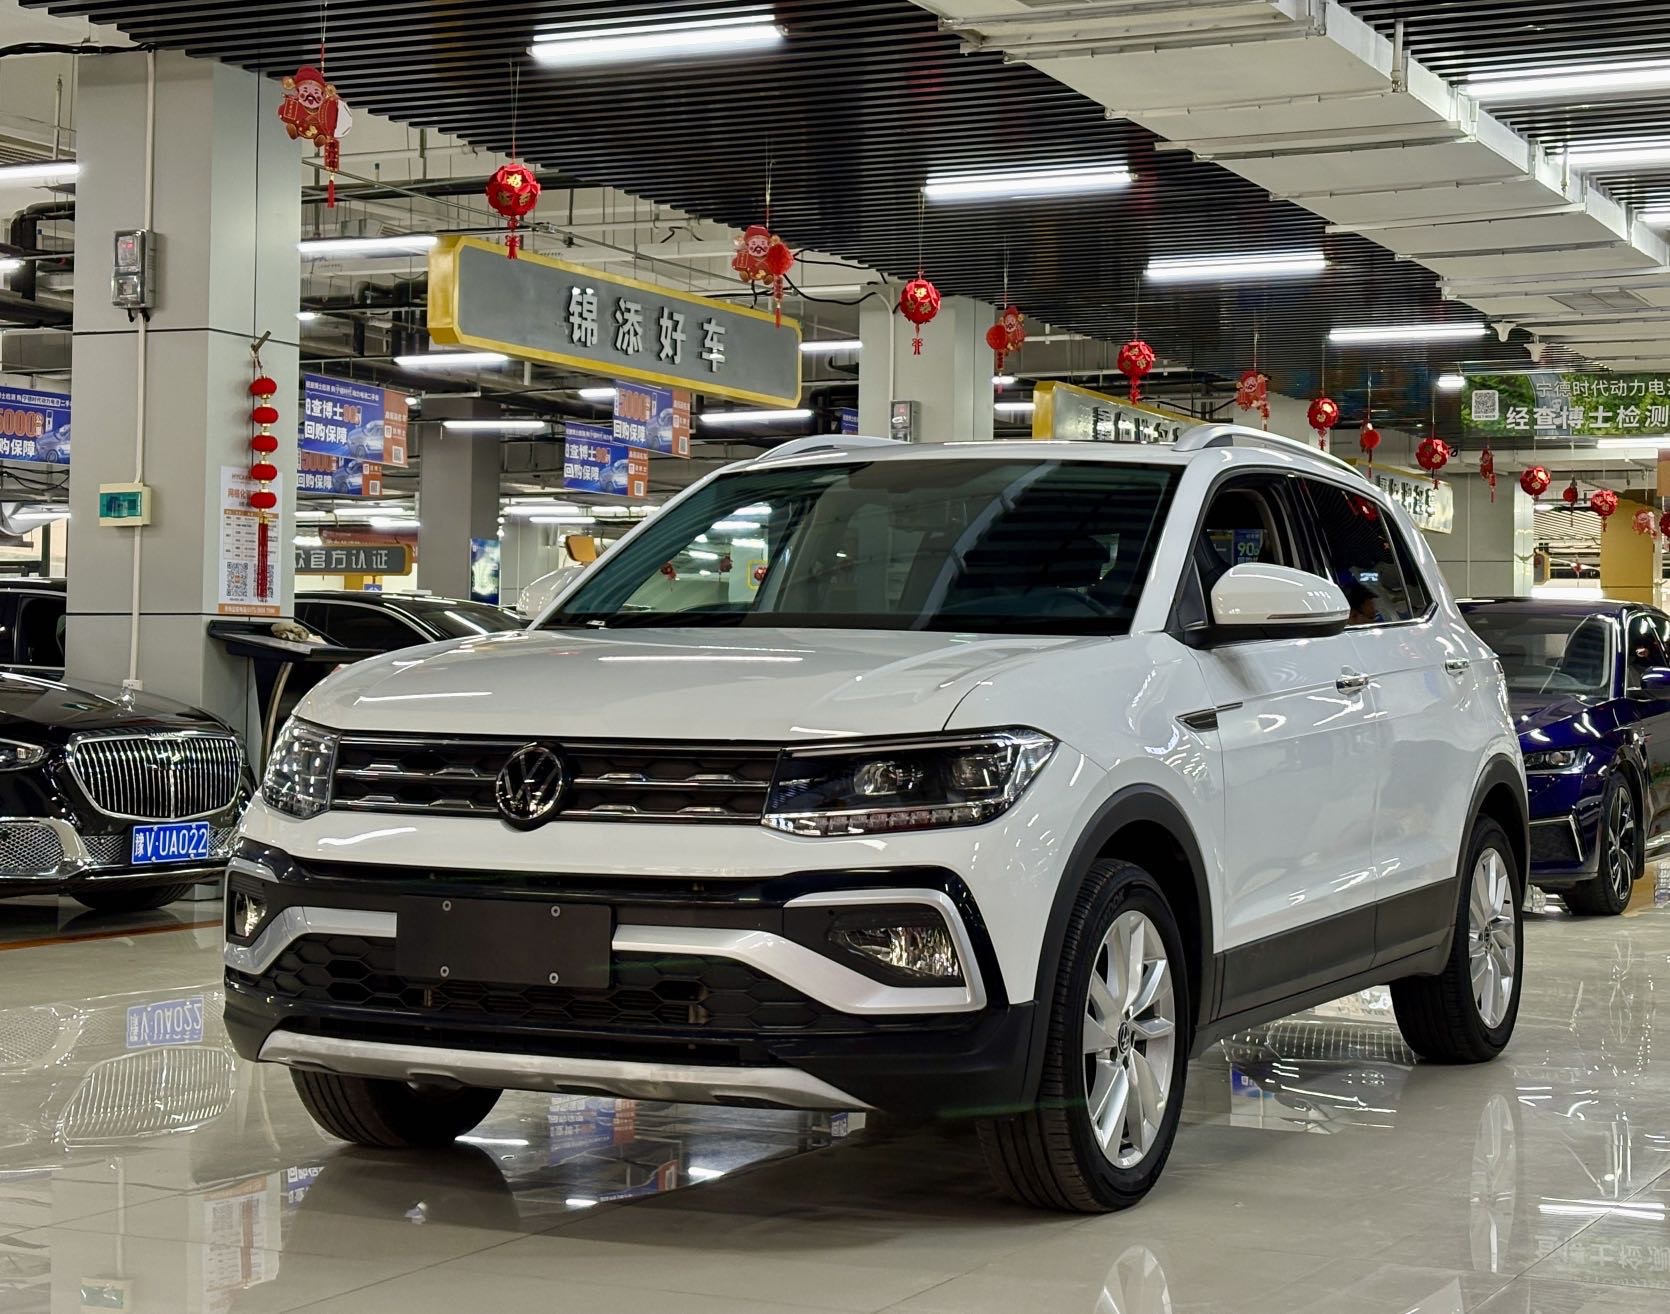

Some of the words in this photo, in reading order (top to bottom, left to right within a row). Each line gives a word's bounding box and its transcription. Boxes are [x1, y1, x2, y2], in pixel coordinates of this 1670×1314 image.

[568, 286, 726, 373] 锦添好车
[1536, 380, 1670, 397] 宁德时代动力电
[1506, 405, 1670, 430] 经查博士检测
[304, 421, 348, 444] 回购保障
[613, 420, 646, 443] 回购保障
[297, 473, 332, 489] 回购保障
[564, 463, 599, 480] 回购保障
